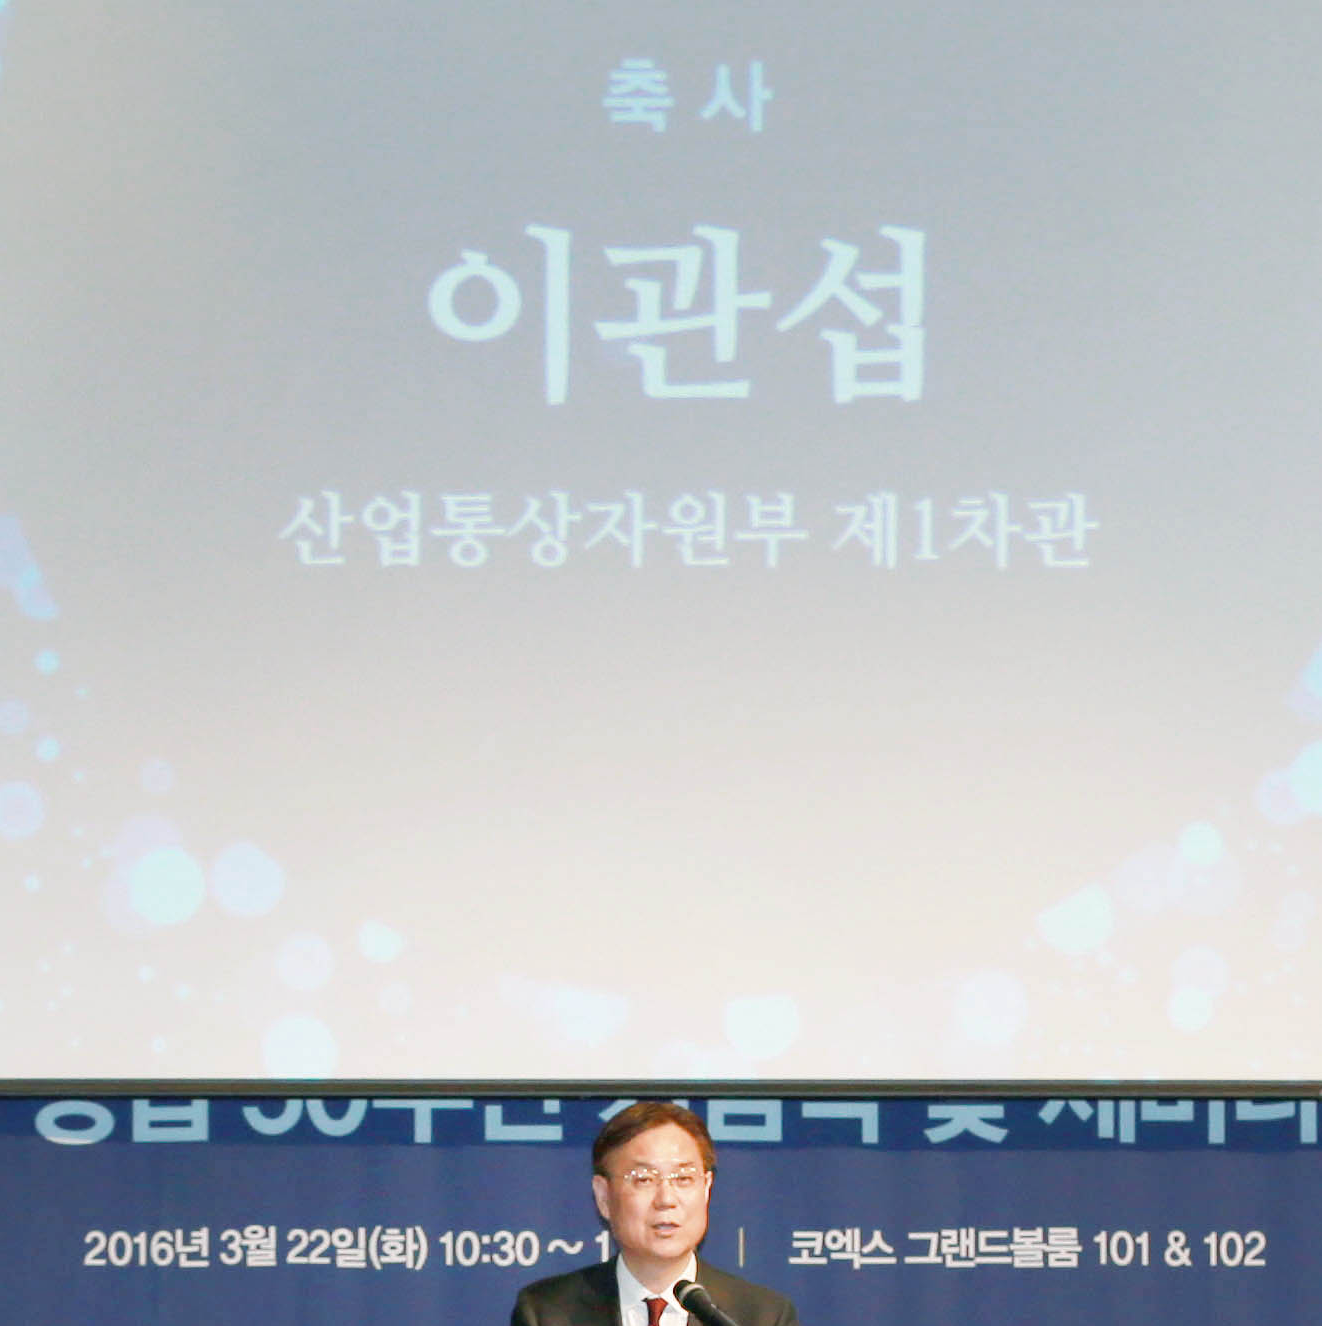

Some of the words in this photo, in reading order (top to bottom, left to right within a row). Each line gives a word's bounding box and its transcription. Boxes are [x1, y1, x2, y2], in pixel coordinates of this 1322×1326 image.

[602, 58, 675, 132] 축
[699, 60, 774, 132] 사
[428, 224, 927, 406] 이관섭
[279, 490, 810, 568] 산업통상자원부
[832, 490, 1099, 569] 제1차관
[83, 1226, 211, 1269] 2016년
[219, 1223, 278, 1268] 3월
[286, 1226, 428, 1271] 22일(화)
[439, 1229, 540, 1267] 10:30
[787, 1226, 898, 1270] 코엑스
[904, 1225, 1084, 1269] 그랜드볼룸
[1093, 1229, 1151, 1267] 101
[1164, 1229, 1193, 1267] &
[1203, 1229, 1267, 1267] 102
